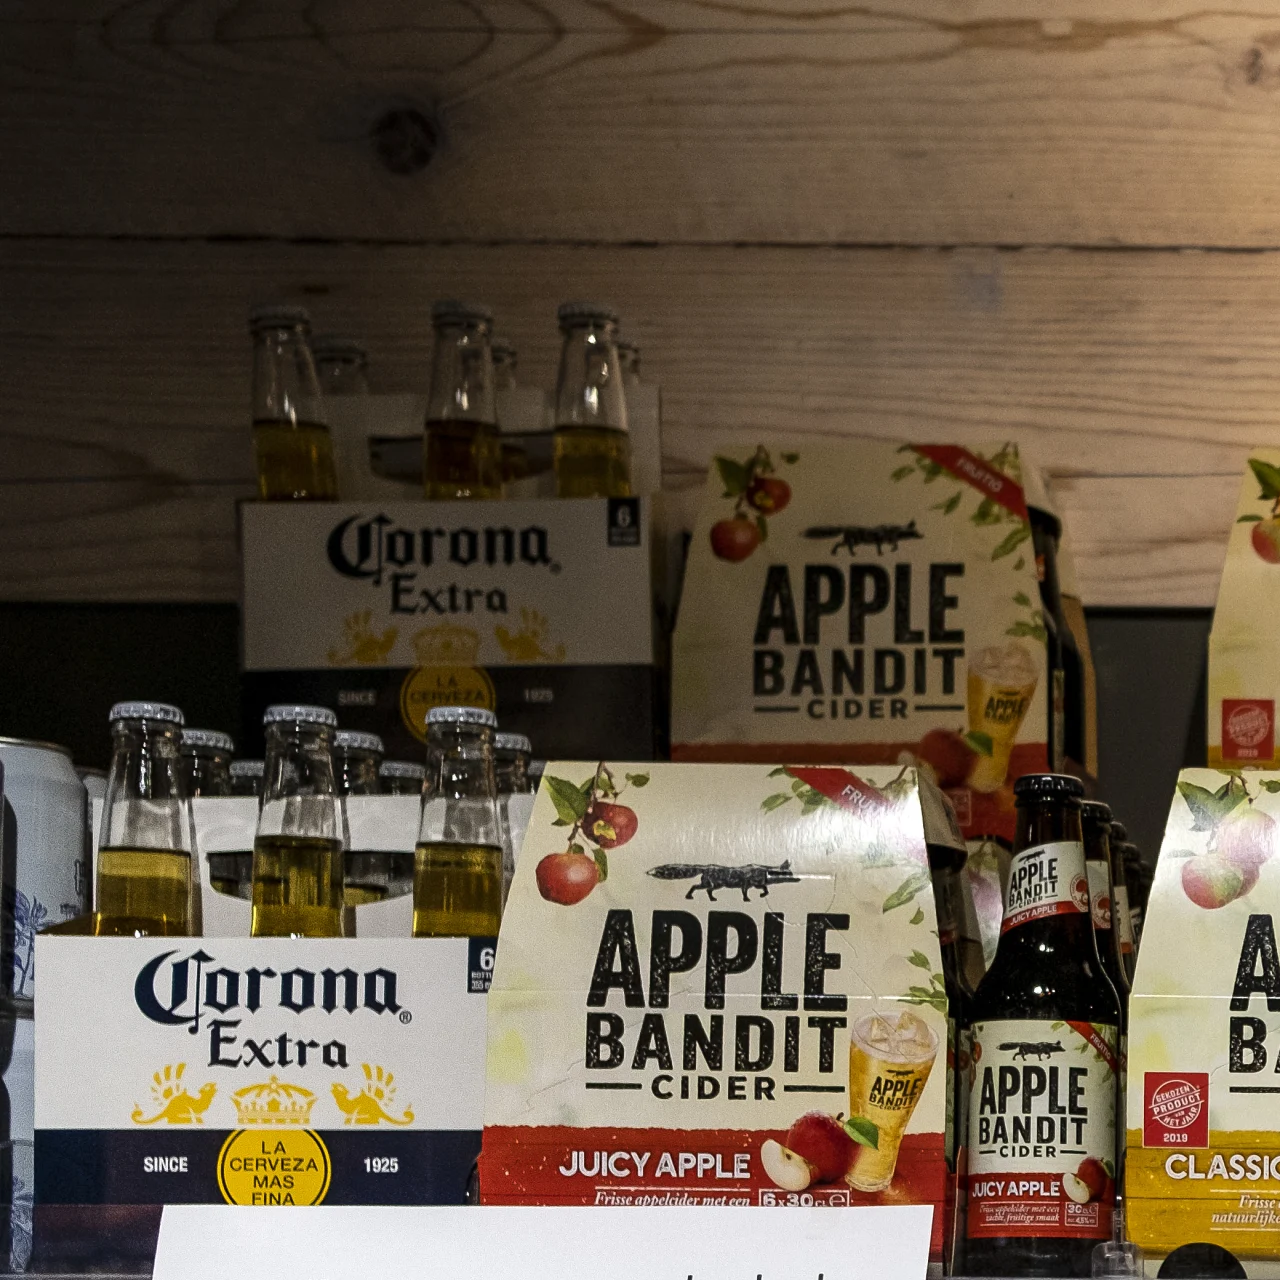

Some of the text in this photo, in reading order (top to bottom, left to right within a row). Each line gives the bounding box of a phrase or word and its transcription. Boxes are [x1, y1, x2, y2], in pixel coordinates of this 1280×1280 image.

[327, 512, 550, 586] Corona
[389, 573, 507, 615] Extra
[754, 563, 965, 645] APPLE
[753, 647, 965, 697] BANDIT
[587, 909, 850, 1012] APPLE
[134, 949, 402, 1034] Corona
[208, 1019, 348, 1068] Extra
[585, 1012, 848, 1073] BANDIT
[651, 1075, 775, 1100] CIDER
[979, 1065, 1088, 1115] APPLE
[979, 1117, 1088, 1145] BANDIT
[261, 1141, 286, 1155] LA
[1000, 1145, 1056, 1158] CIDER
[143, 1157, 188, 1173] SINCE
[230, 1157, 318, 1172] CERVEZA
[364, 1157, 398, 1173] 1925
[559, 1151, 751, 1179] JUICY APPLE
[253, 1176, 294, 1189] MAS
[972, 1182, 1060, 1198] JUICY APPLE
